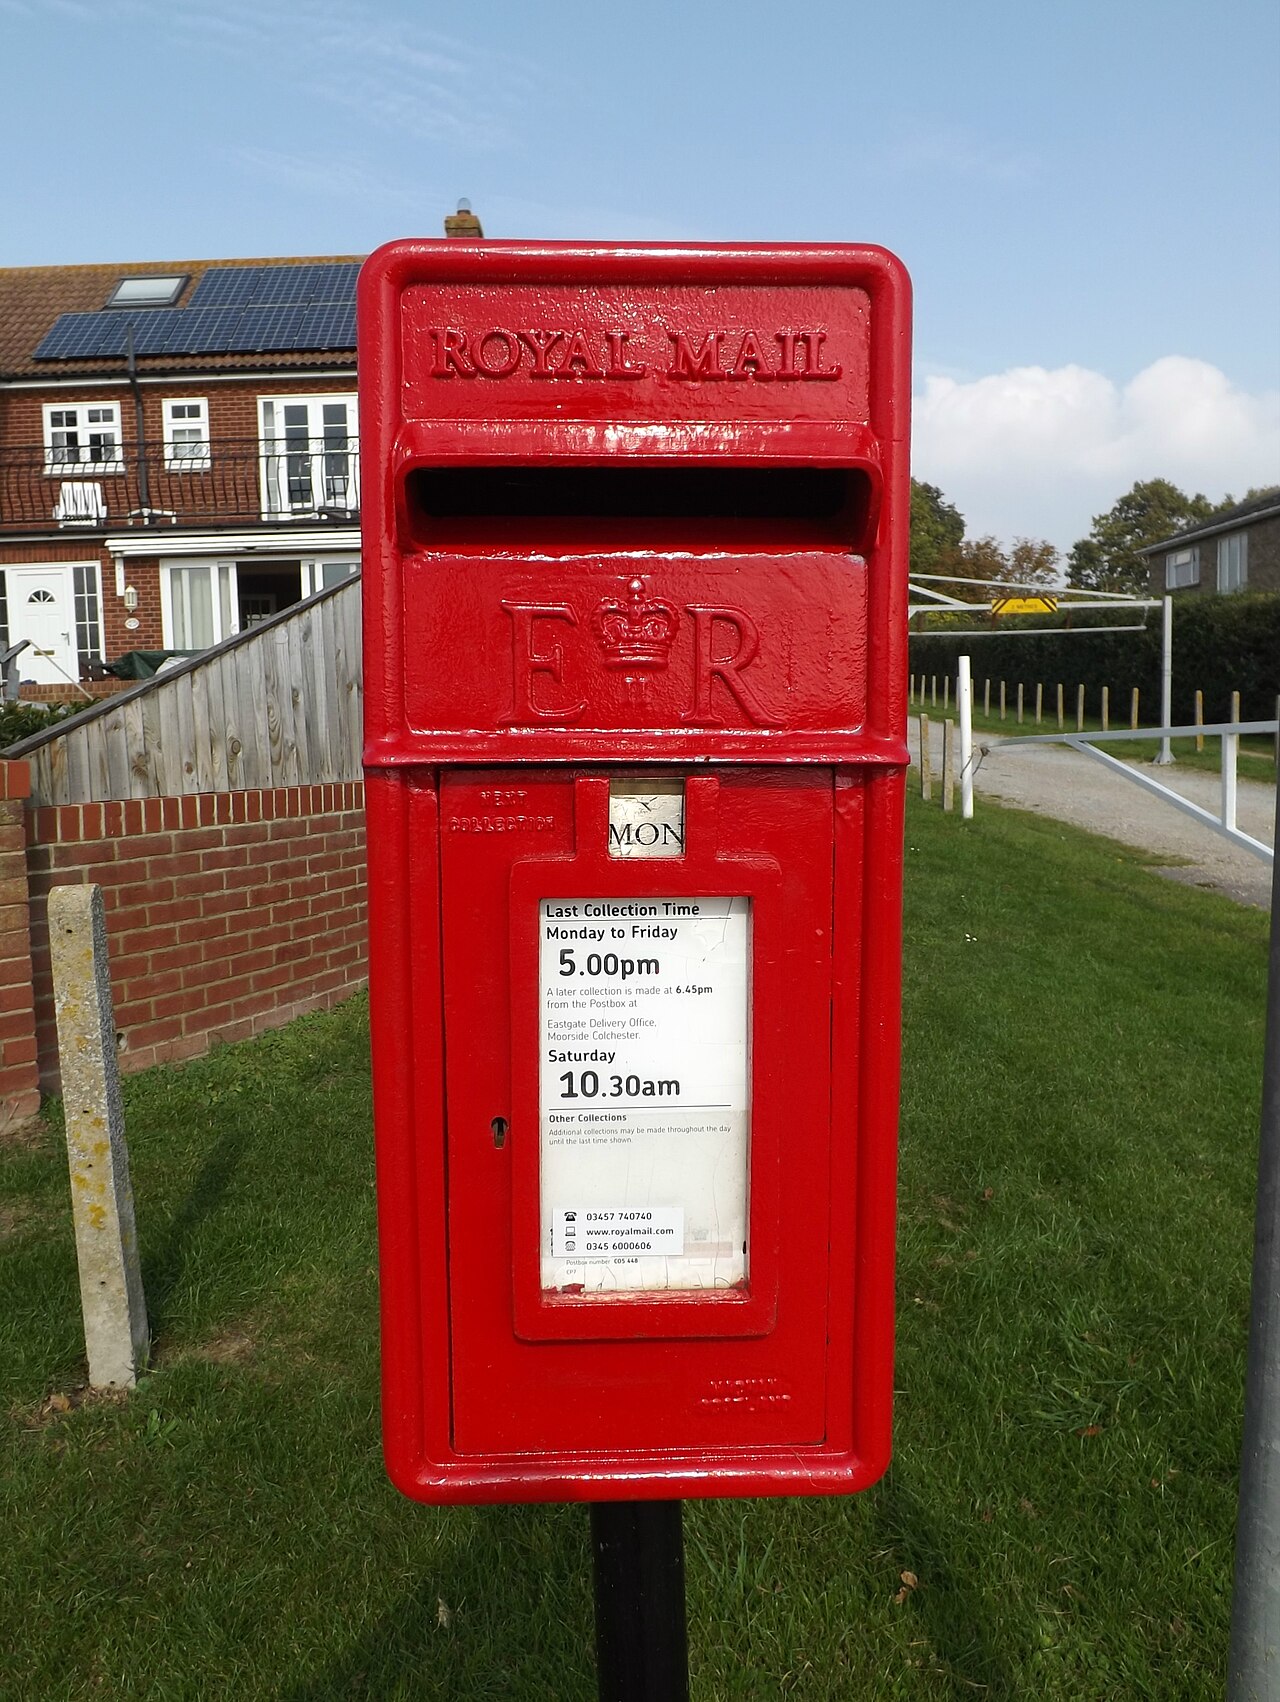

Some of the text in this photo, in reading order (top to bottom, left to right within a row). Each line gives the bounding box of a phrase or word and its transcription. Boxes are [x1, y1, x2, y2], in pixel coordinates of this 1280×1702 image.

[428, 328, 843, 382] ROYAL MAIL
[450, 815, 555, 832] COLLECTION
[608, 822, 685, 853] MON
[546, 902, 700, 918] Last Collection Time
[546, 925, 678, 942] Monday to Friday
[558, 948, 660, 980] 5.00pm
[546, 984, 714, 996] A later collection is made at 6.45pm
[547, 998, 638, 1009] from the Postbox at
[547, 1019, 587, 1030] Eastgate
[589, 1018, 627, 1029] Delivery
[547, 1031, 641, 1041] Moorside Colchester.
[548, 1049, 616, 1064] Saturday
[559, 1070, 681, 1098] 10.30am
[549, 1113, 628, 1123] Other Collections
[584, 1128, 618, 1136] collections
[646, 1126, 666, 1134] made
[667, 1126, 705, 1134] throughout
[706, 1125, 718, 1133] the
[719, 1125, 732, 1133] day
[579, 1137, 591, 1145] last
[586, 1212, 652, 1221] 03457 740740
[586, 1227, 674, 1237] www.royalmail.com
[586, 1241, 652, 1251] 0345 6000606
